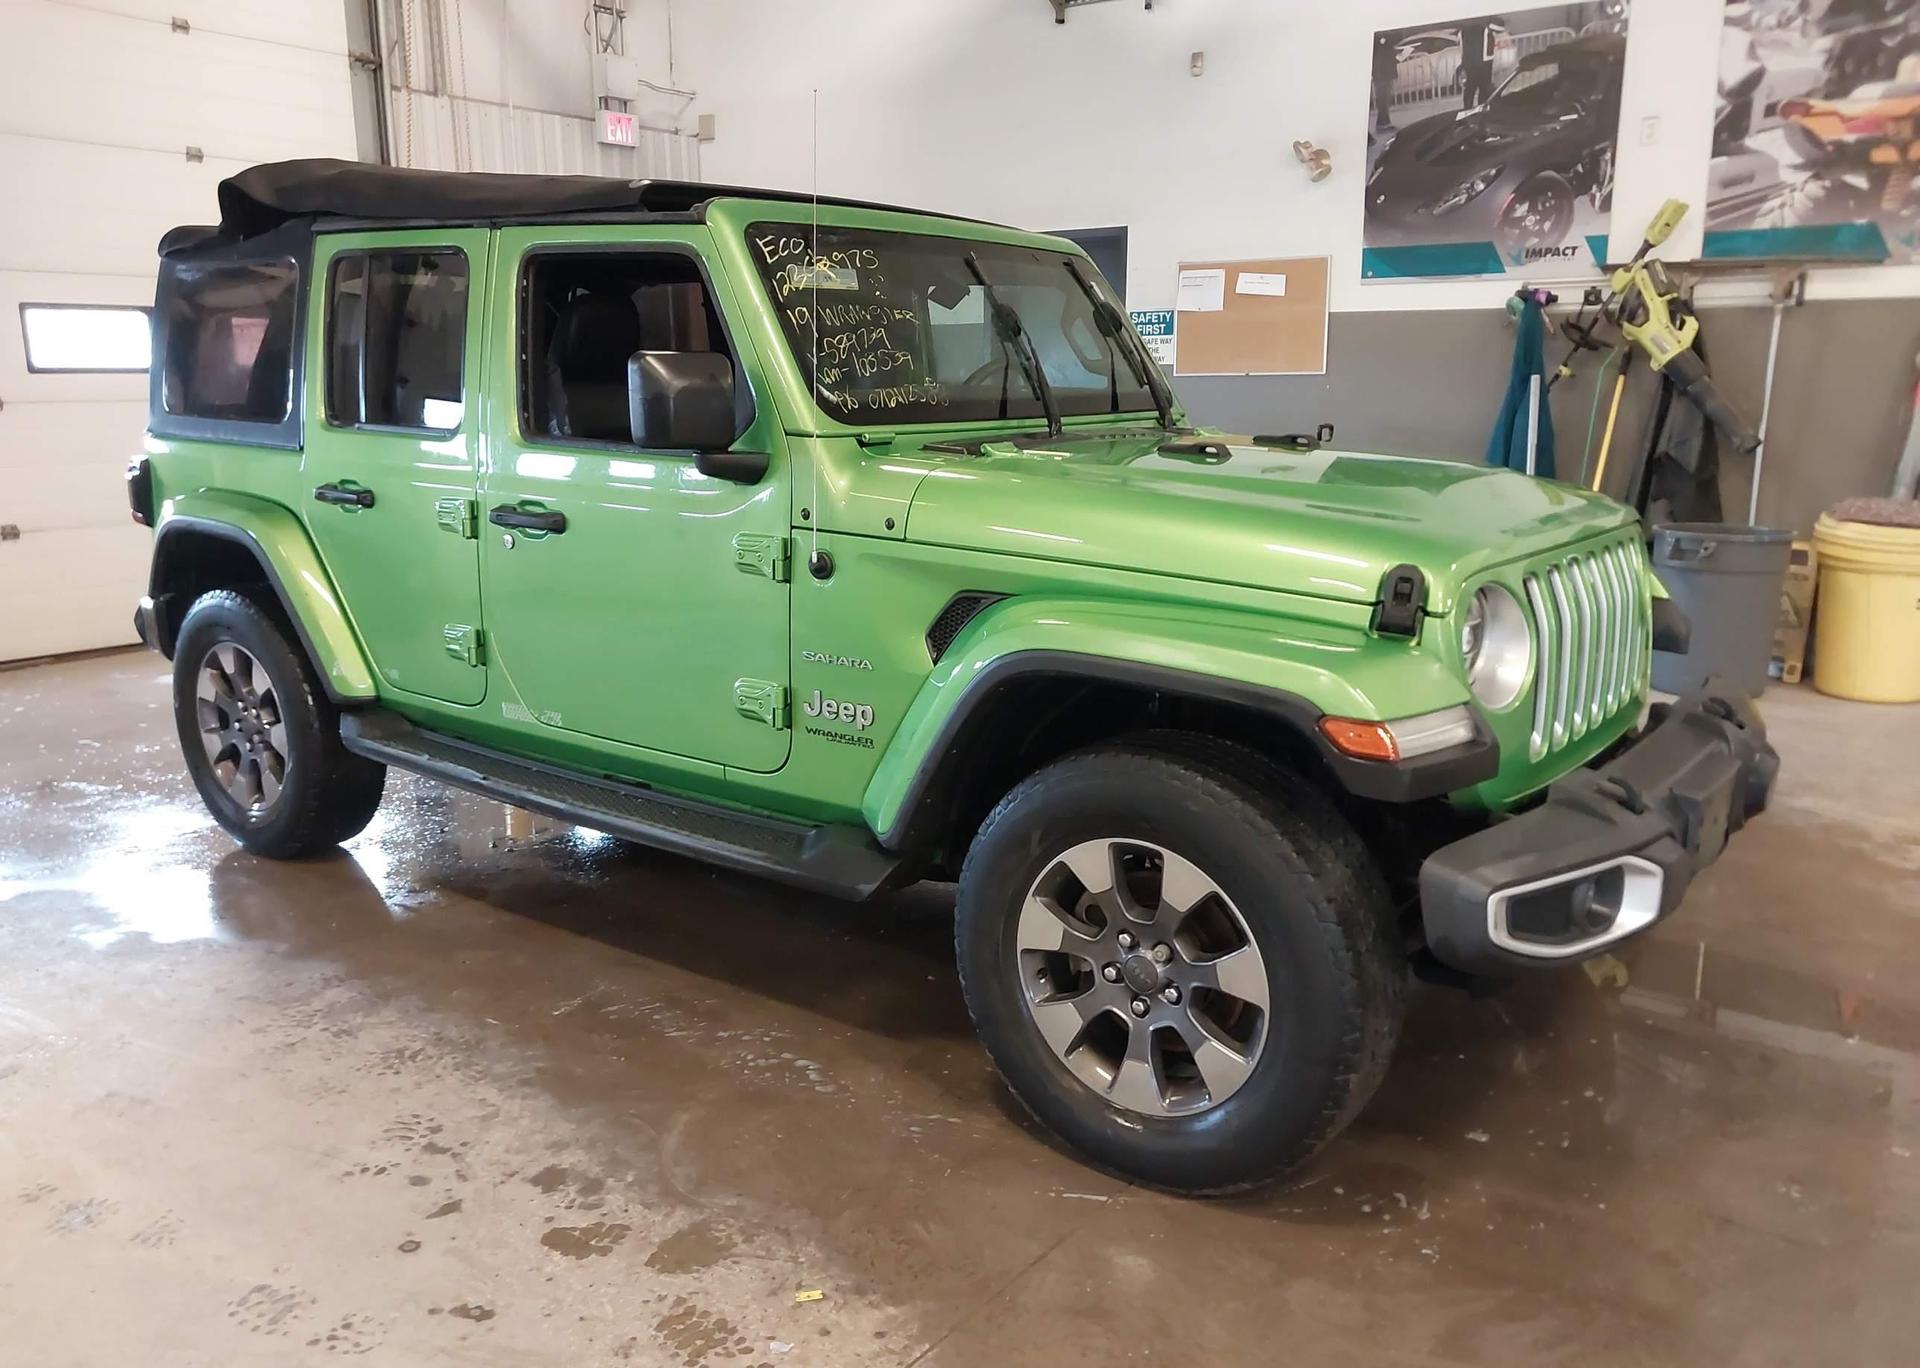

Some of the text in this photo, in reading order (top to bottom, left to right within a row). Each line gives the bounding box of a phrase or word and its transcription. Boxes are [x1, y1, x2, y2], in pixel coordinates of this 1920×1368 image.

[607, 115, 633, 143] EXIT
[1525, 246, 1578, 258] IMPACT
[1131, 312, 1172, 323] SAFETY
[1137, 324, 1166, 335] FIRST
[802, 650, 873, 671] SAHARA
[803, 689, 875, 731] Jeep
[805, 726, 874, 746] WRANGLER
